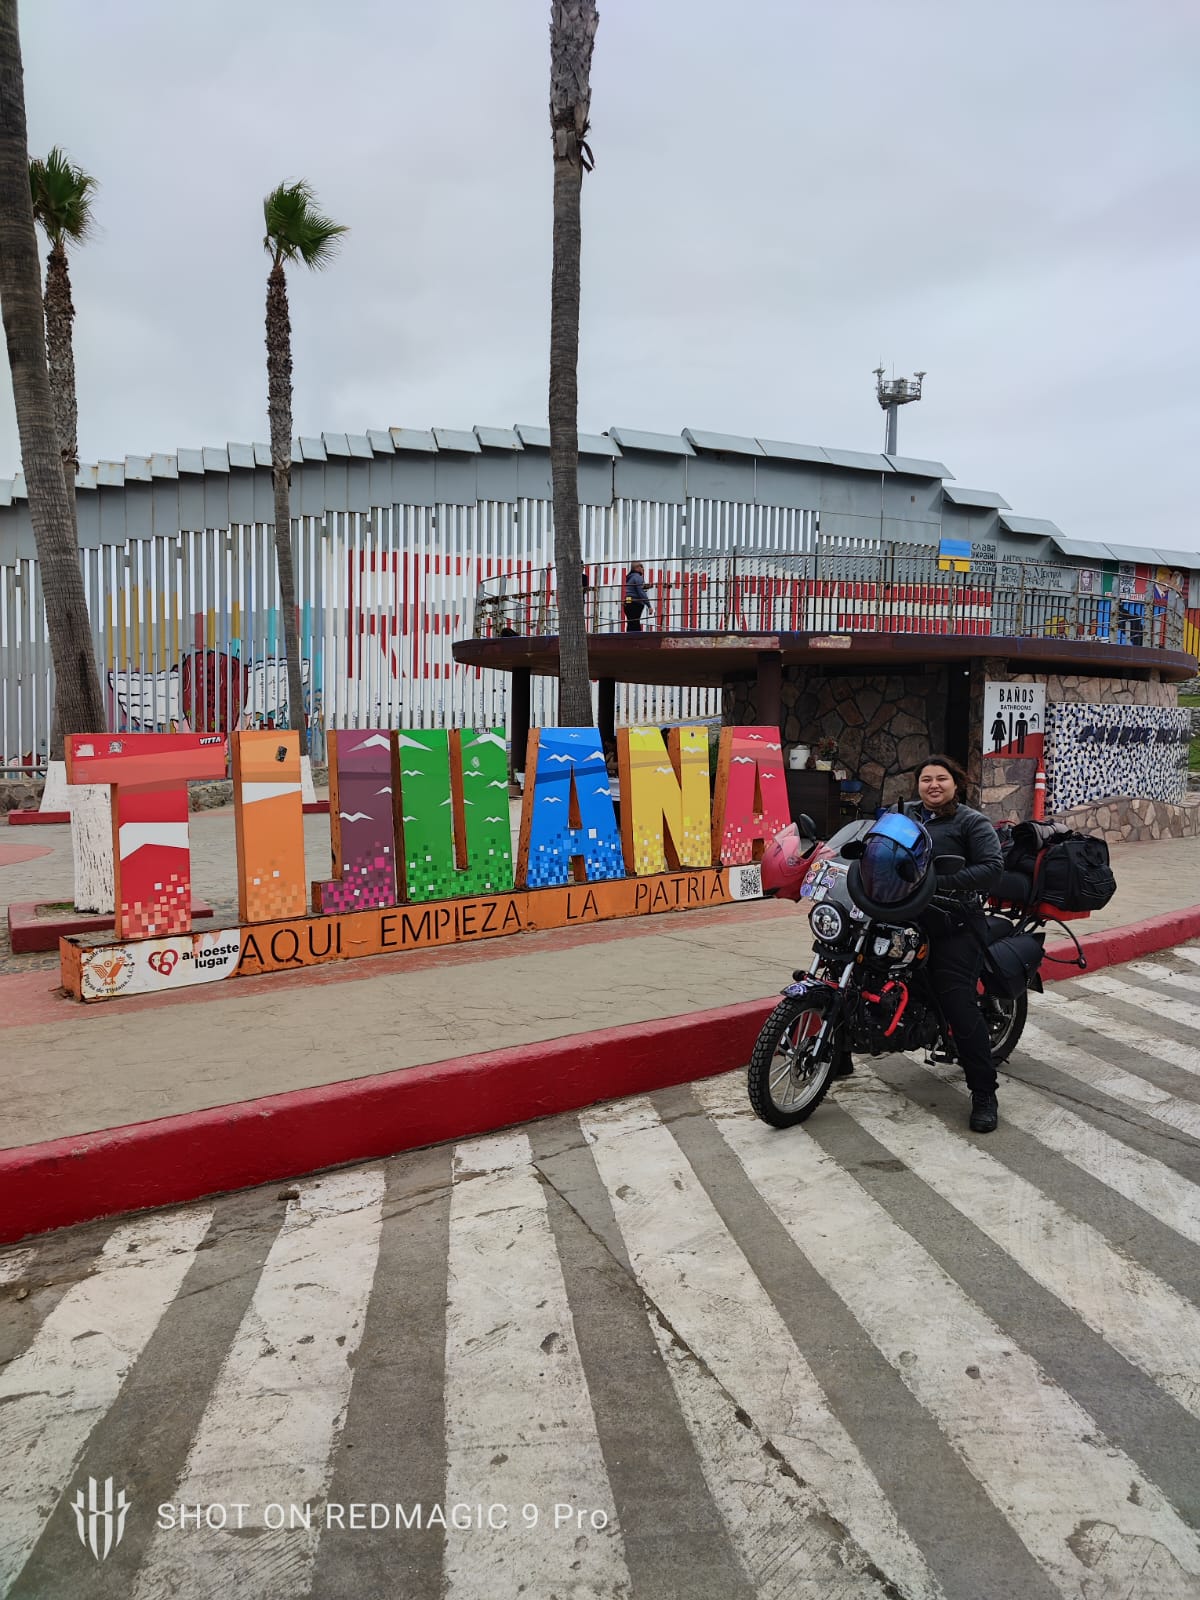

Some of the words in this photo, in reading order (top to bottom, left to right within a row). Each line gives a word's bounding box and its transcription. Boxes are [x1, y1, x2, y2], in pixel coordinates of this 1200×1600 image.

[999, 686, 1034, 703] BAÑOS
[65, 726, 791, 940] TIJUANA
[237, 922, 342, 968] AQUI
[381, 900, 522, 947] EMPIEZA
[566, 889, 599, 919] LA
[635, 873, 725, 909] PATRIA
[195, 957, 229, 969] lugar
